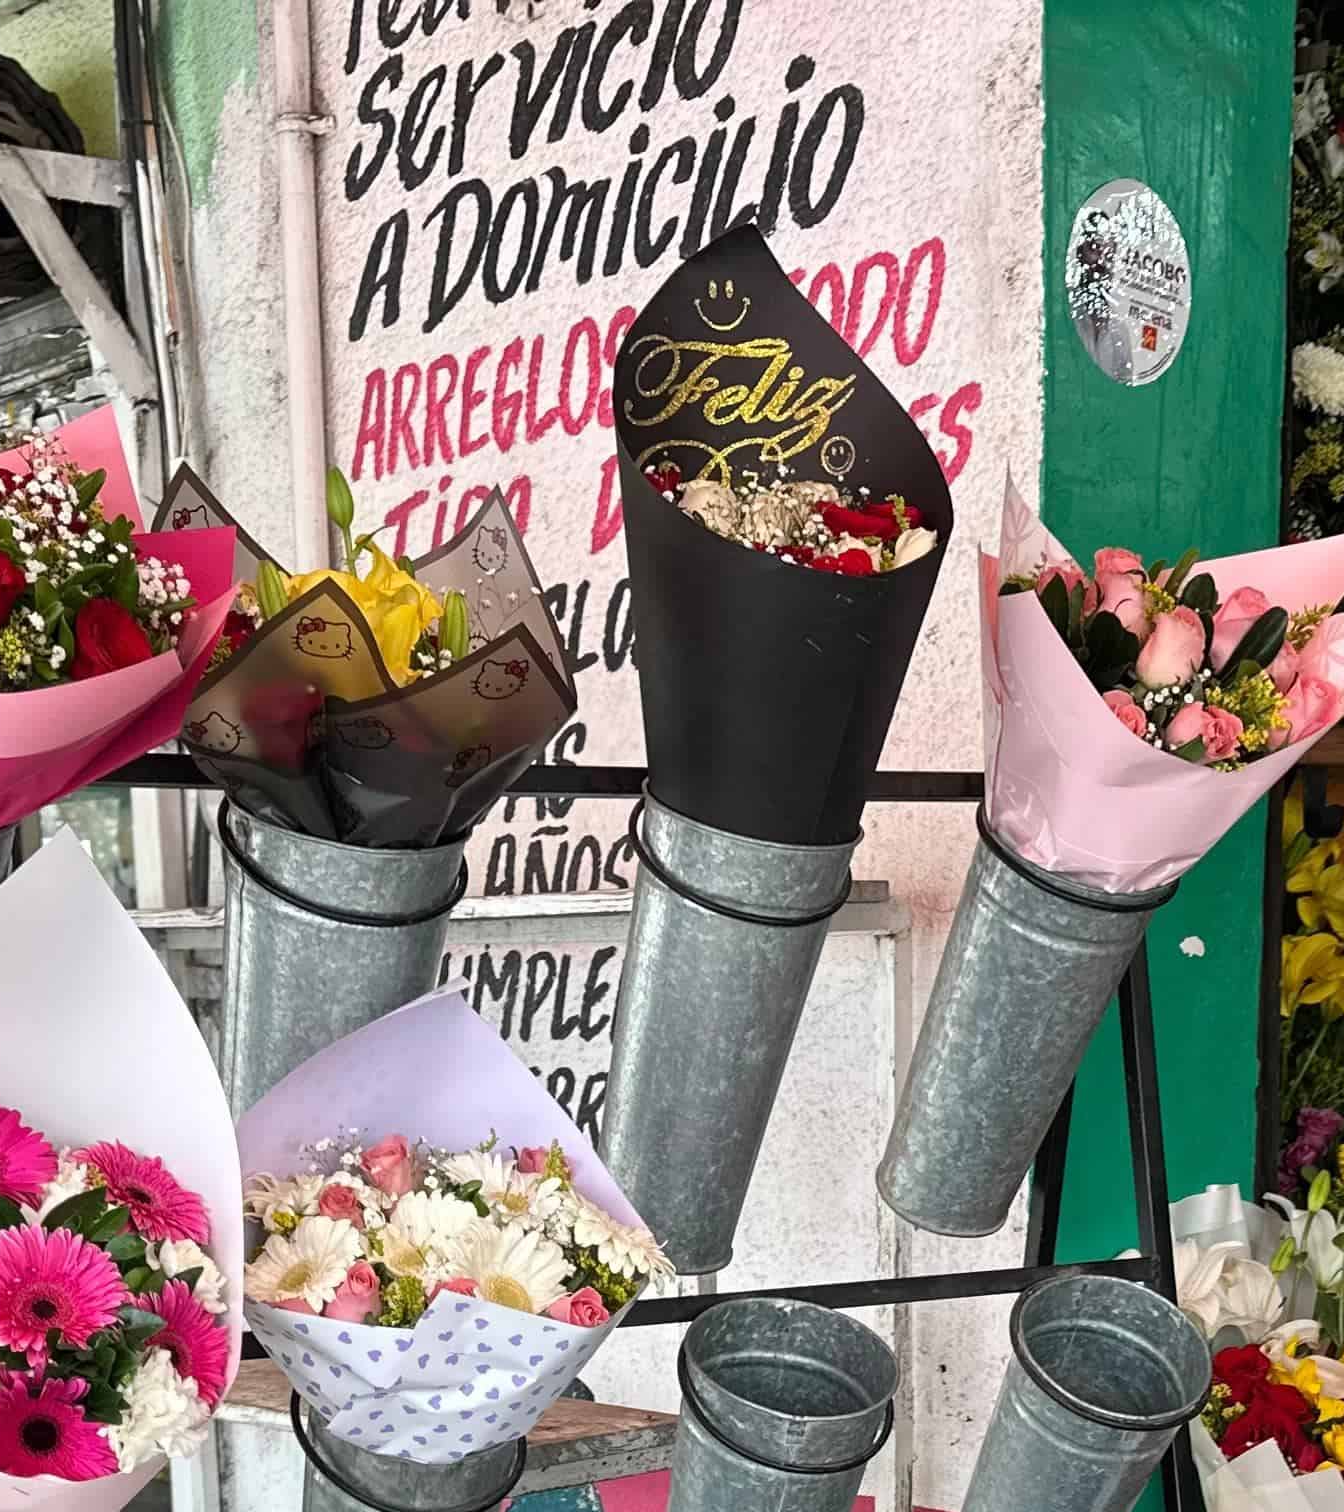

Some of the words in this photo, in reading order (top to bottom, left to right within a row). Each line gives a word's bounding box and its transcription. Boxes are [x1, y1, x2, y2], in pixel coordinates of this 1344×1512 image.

[350, 209, 408, 341] A
[351, 305, 637, 481] ARREGLOS
[787, 236, 946, 368] ODO
[624, 334, 857, 462] Feliz
